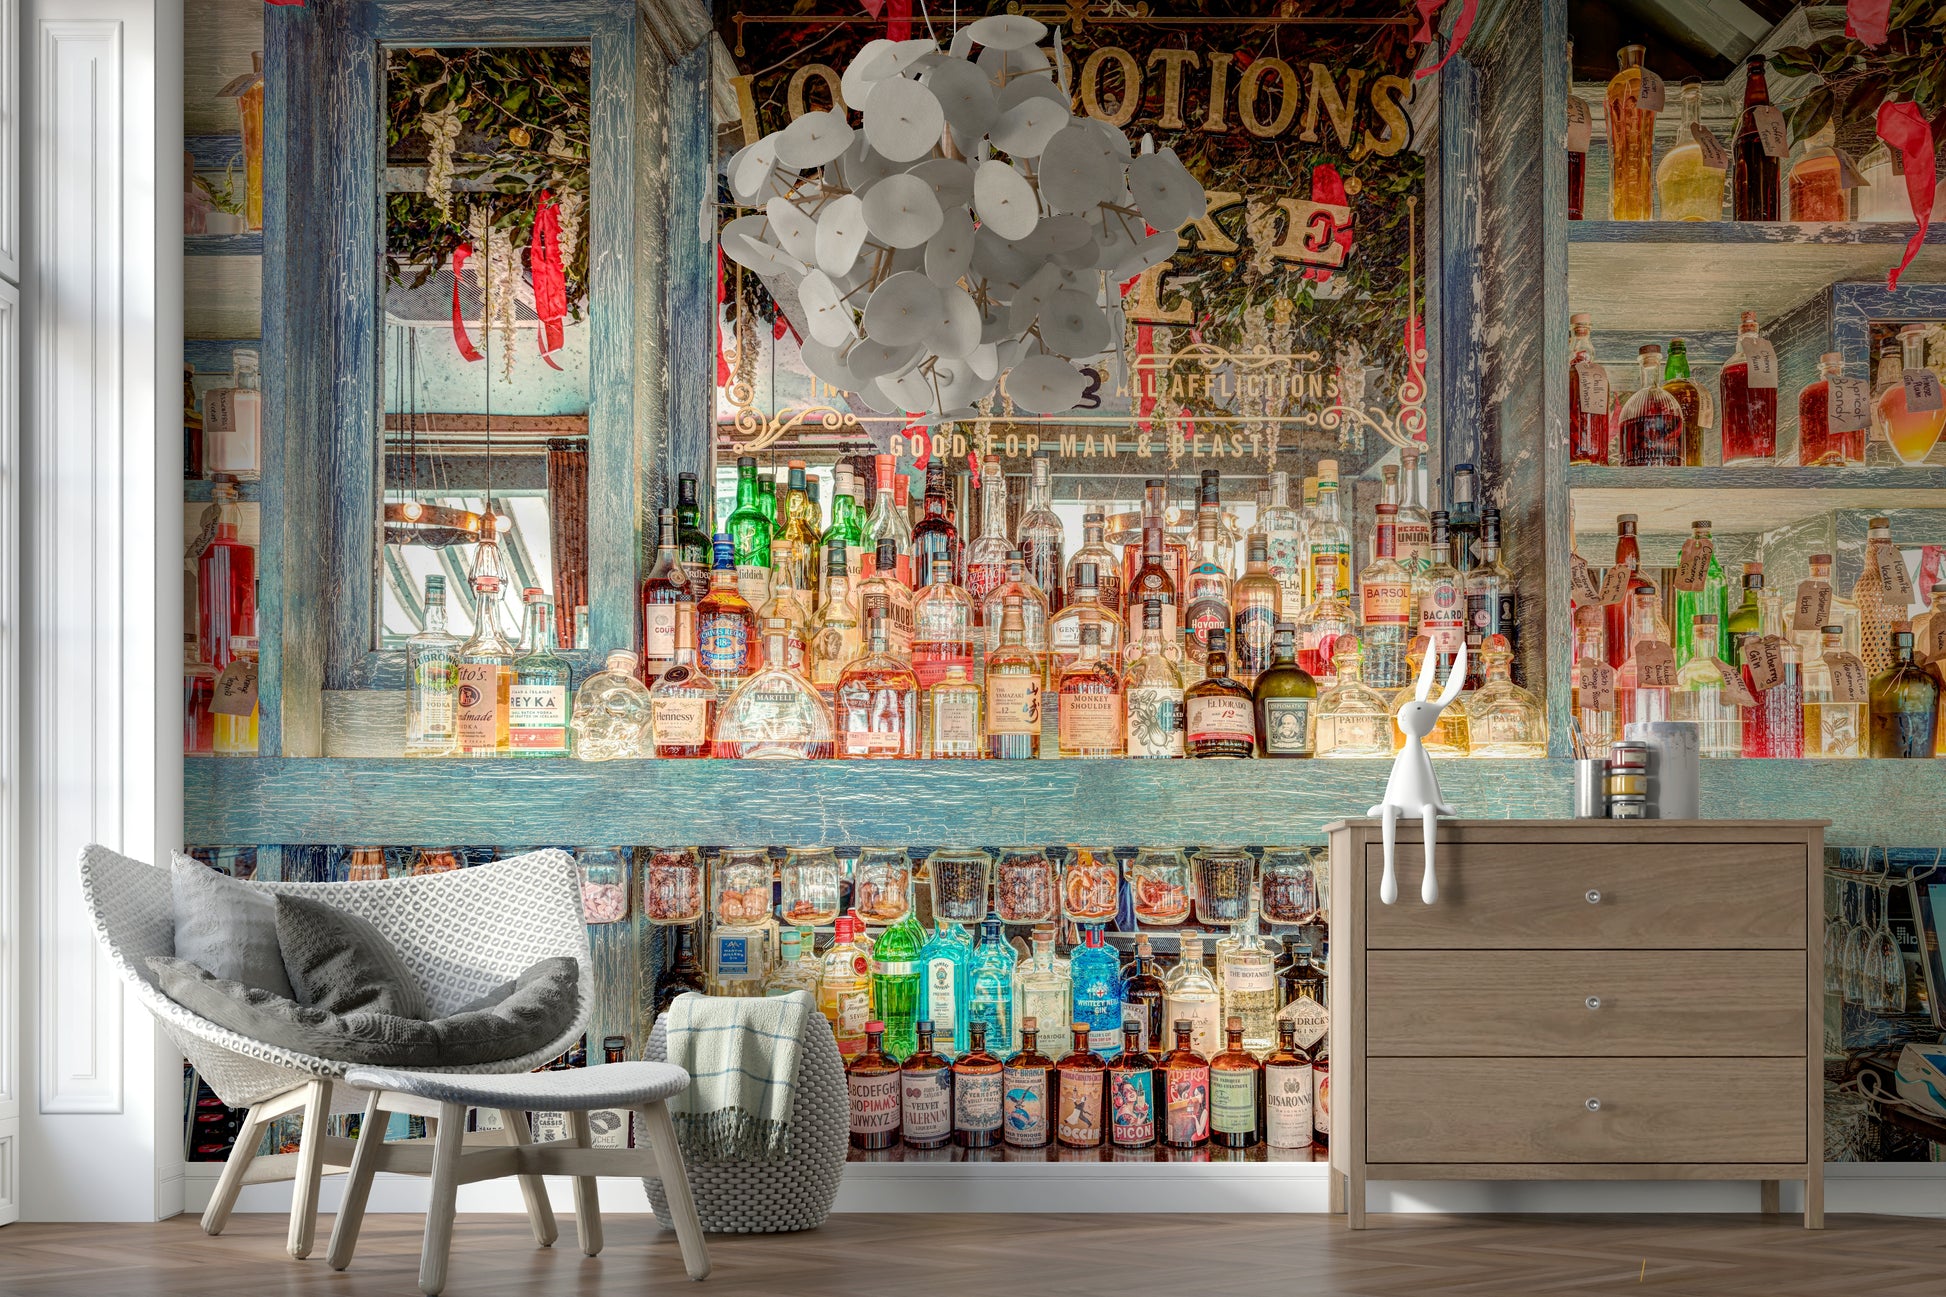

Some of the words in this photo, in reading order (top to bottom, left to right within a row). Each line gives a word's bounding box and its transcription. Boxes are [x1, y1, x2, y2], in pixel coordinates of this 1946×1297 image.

[1771, 121, 1784, 145] Coffee
[1117, 374, 1157, 398] ALL
[1172, 373, 1341, 399] AFFLICTIONS
[1592, 373, 1602, 395] Chilli
[1829, 377, 1850, 424] Brandy
[1847, 379, 1866, 421] Apricot
[889, 434, 967, 458] GOOD
[985, 433, 1041, 458] FOR
[1059, 433, 1117, 458] MAN
[1136, 434, 1152, 458] &
[1173, 434, 1264, 458] BEAST
[1680, 562, 1689, 577] Gin
[1698, 545, 1713, 582] Cucumber
[738, 569, 764, 581] fiddich
[1881, 564, 1892, 592] Vodka
[1366, 588, 1408, 598] BARSOL
[1191, 618, 1226, 629] Havana
[1749, 649, 1761, 670] Gin
[1644, 665, 1653, 681] Gin
[1721, 670, 1733, 686] Gin
[1833, 670, 1842, 687] Gin
[1581, 674, 1590, 690] Gin
[756, 693, 793, 702] MARTELL
[1073, 695, 1109, 703] MONKEY
[1207, 699, 1217, 709] EL
[1218, 699, 1247, 711] DORADO
[1001, 706, 1009, 715] 12
[1070, 702, 1112, 710] SHOULDER
[656, 711, 695, 723] Hennessy
[1221, 710, 1235, 719] 12
[1229, 970, 1241, 978] THE
[1242, 970, 1271, 979] BOTANIST
[1094, 1006, 1108, 1015] GIN
[968, 1090, 999, 1098] VERMOUTH
[911, 1101, 940, 1110] VELVET
[905, 1109, 948, 1125] FALERNUM
[1115, 1124, 1152, 1139] PICON
